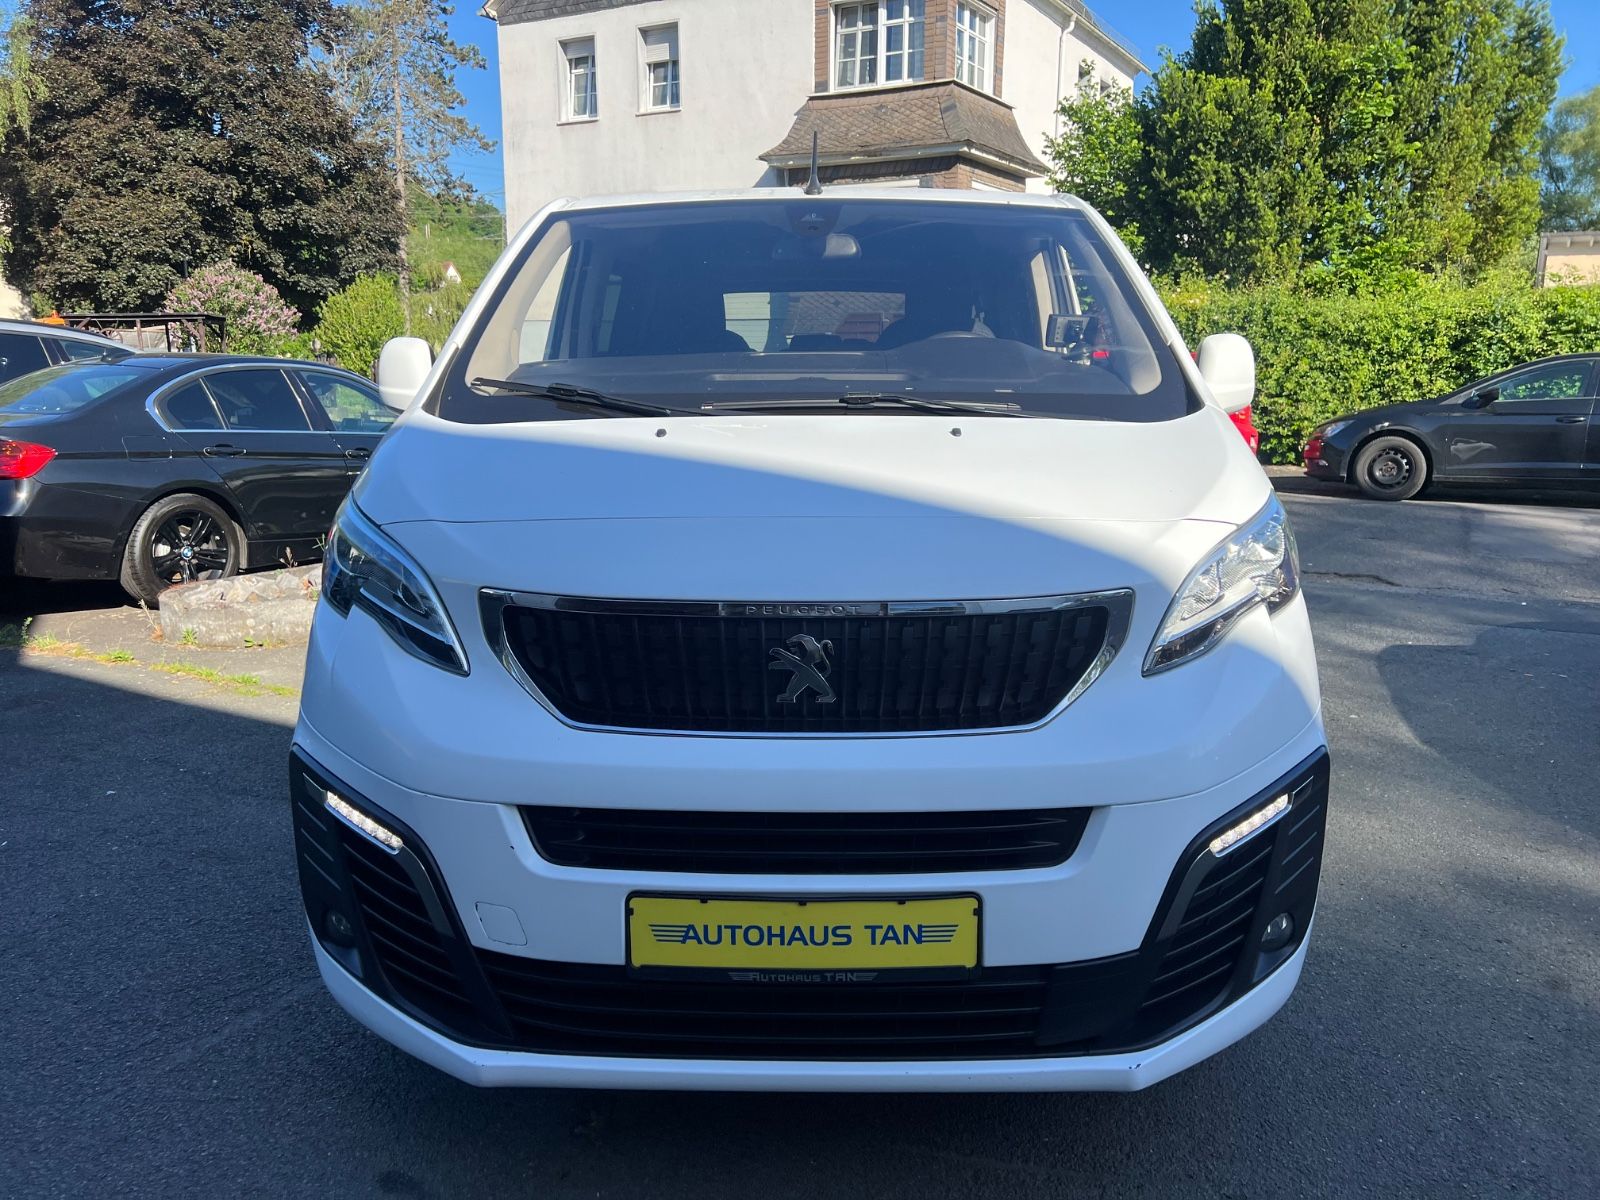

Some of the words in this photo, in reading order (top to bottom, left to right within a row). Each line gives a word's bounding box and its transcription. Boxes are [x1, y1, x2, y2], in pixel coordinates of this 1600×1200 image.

[746, 605, 861, 616] PEUGEOT
[680, 924, 853, 946] AUTOHAUS
[863, 924, 923, 946] TAN
[824, 972, 857, 983] TAN
